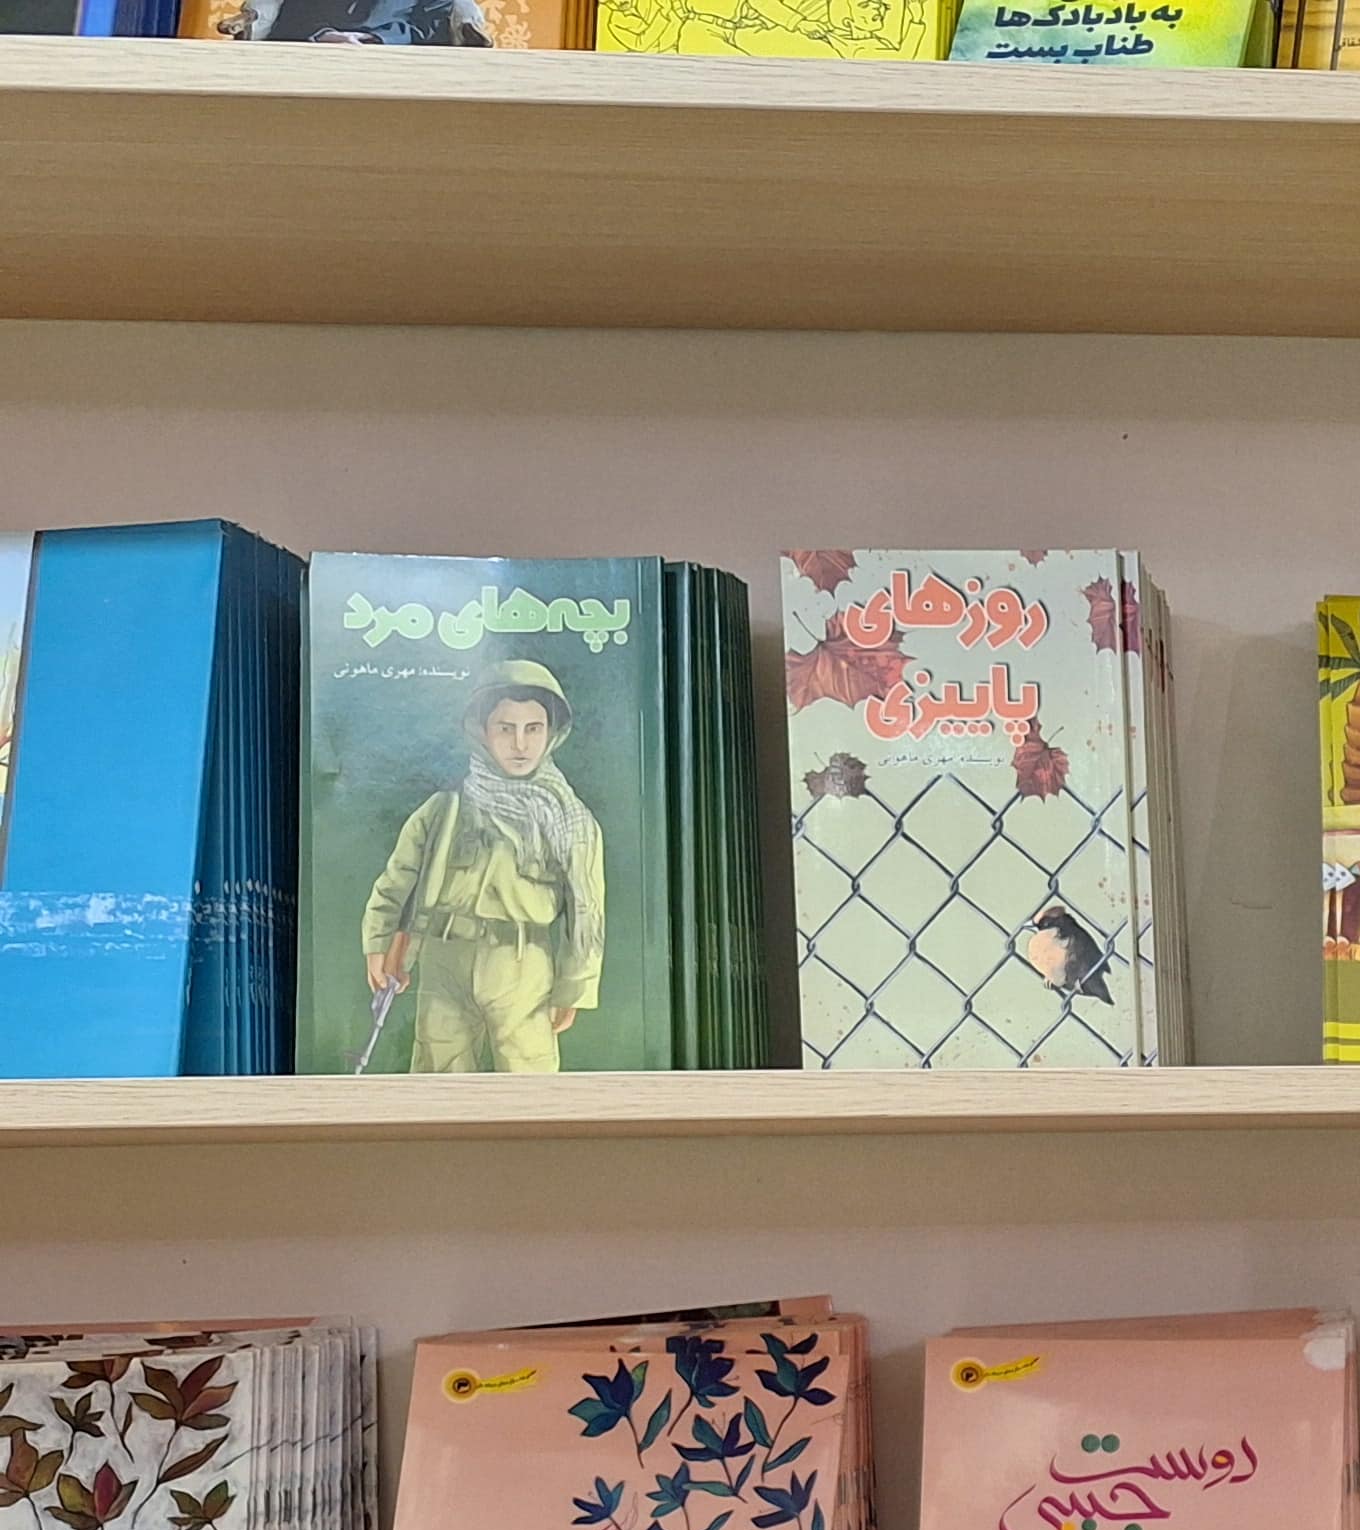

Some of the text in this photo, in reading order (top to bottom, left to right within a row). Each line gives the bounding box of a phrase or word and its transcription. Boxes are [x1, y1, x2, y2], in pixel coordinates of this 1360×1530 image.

[1152, 8, 1184, 29] به
[986, 33, 1154, 63] طناب بست
[344, 591, 435, 649] مرد
[843, 569, 1050, 650] روزهای
[380, 665, 416, 679] مهری
[864, 664, 1040, 748] پاییزی
